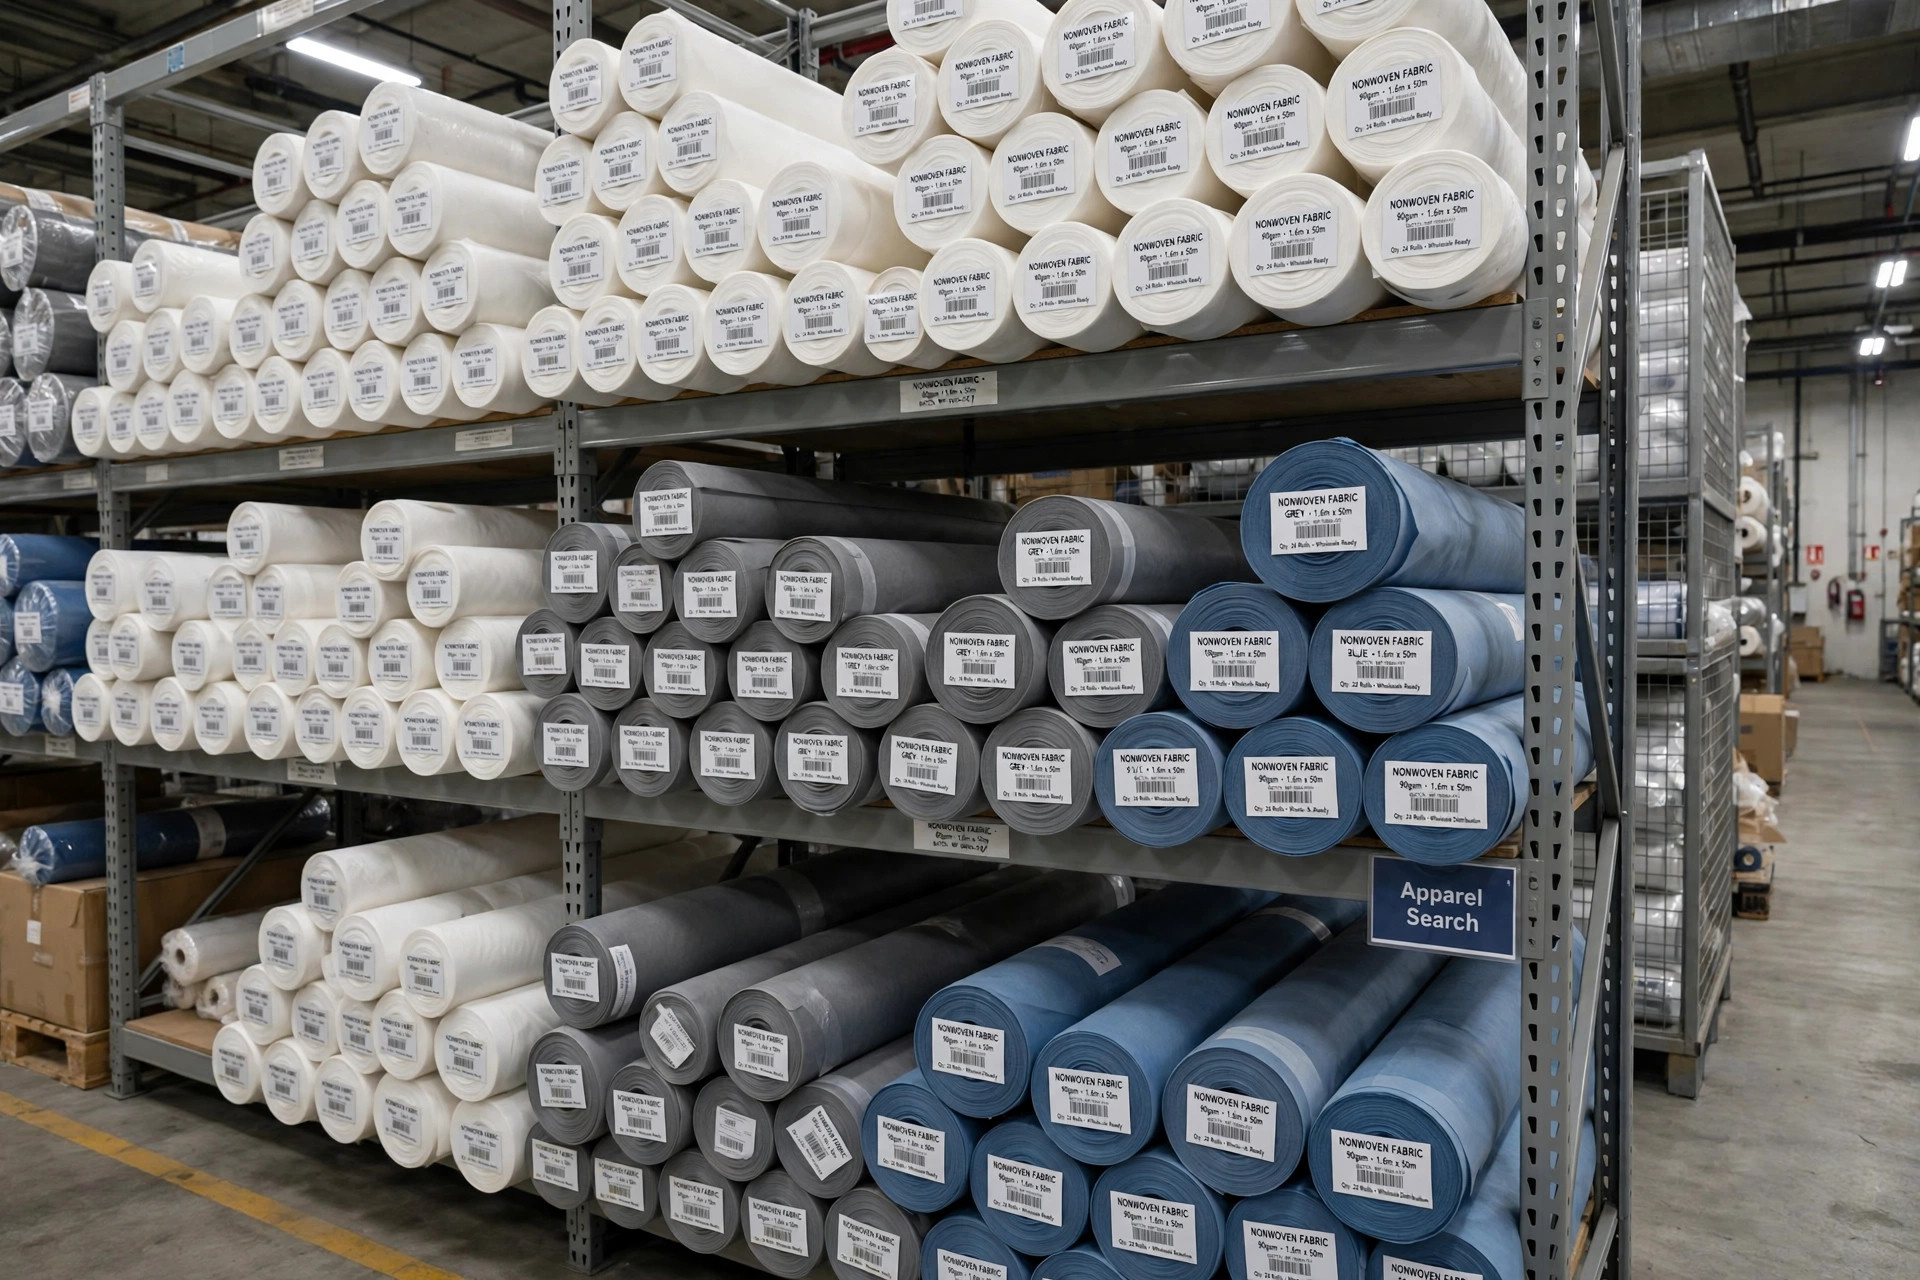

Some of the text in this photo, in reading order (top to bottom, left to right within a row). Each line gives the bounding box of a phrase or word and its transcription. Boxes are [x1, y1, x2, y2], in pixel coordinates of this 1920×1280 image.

[1063, 24, 1103, 41] NONWOVEN
[1352, 63, 1433, 90] NONWOVEN FABRIC
[1413, 79, 1428, 89] 50m
[1227, 94, 1301, 120] NONWOVEN FABRIC
[1114, 120, 1182, 143] NONWOVEN FABRIC
[1007, 149, 1045, 164] NONWOVEN
[1390, 189, 1475, 210] NONWOVEN FABRIC
[1452, 205, 1468, 215] 50m
[1255, 210, 1332, 229] NONWOVEN FABRIC
[1133, 232, 1204, 252] NONWOVEN FABRIC
[1277, 492, 1358, 507] NONWOVEN FABRIC
[1337, 507, 1353, 516] 50m
[1197, 636, 1272, 646] NONWOVEN FABRIC
[1340, 635, 1424, 646] NONWOVEN FABRIC
[1068, 643, 1135, 655] NONWOVEN FABRIC
[1253, 649, 1267, 658] 50m
[1402, 649, 1417, 659] 50m
[1041, 753, 1065, 763] FABRIC
[1120, 753, 1190, 763] NONWOVEN FABRIC
[1251, 761, 1329, 772] NONWOVEN FABRIC
[1392, 767, 1479, 780] NONWOVEN FABRIC
[1309, 775, 1324, 784] 50m
[1456, 783, 1473, 792] 50m
[1400, 881, 1483, 907] Apparel
[1406, 907, 1479, 933] Search
[1054, 1072, 1123, 1090] NONWOVEN FABRIC
[1193, 1091, 1270, 1115] NONWOVEN FABRIC
[1338, 1136, 1424, 1159] NONWOVEN FABRIC
[1117, 1197, 1189, 1219] NONWOVEN FABRIC
[1250, 1227, 1329, 1247] NONWOVEN FABRIC
[1391, 1263, 1441, 1280] NONWOVEN
